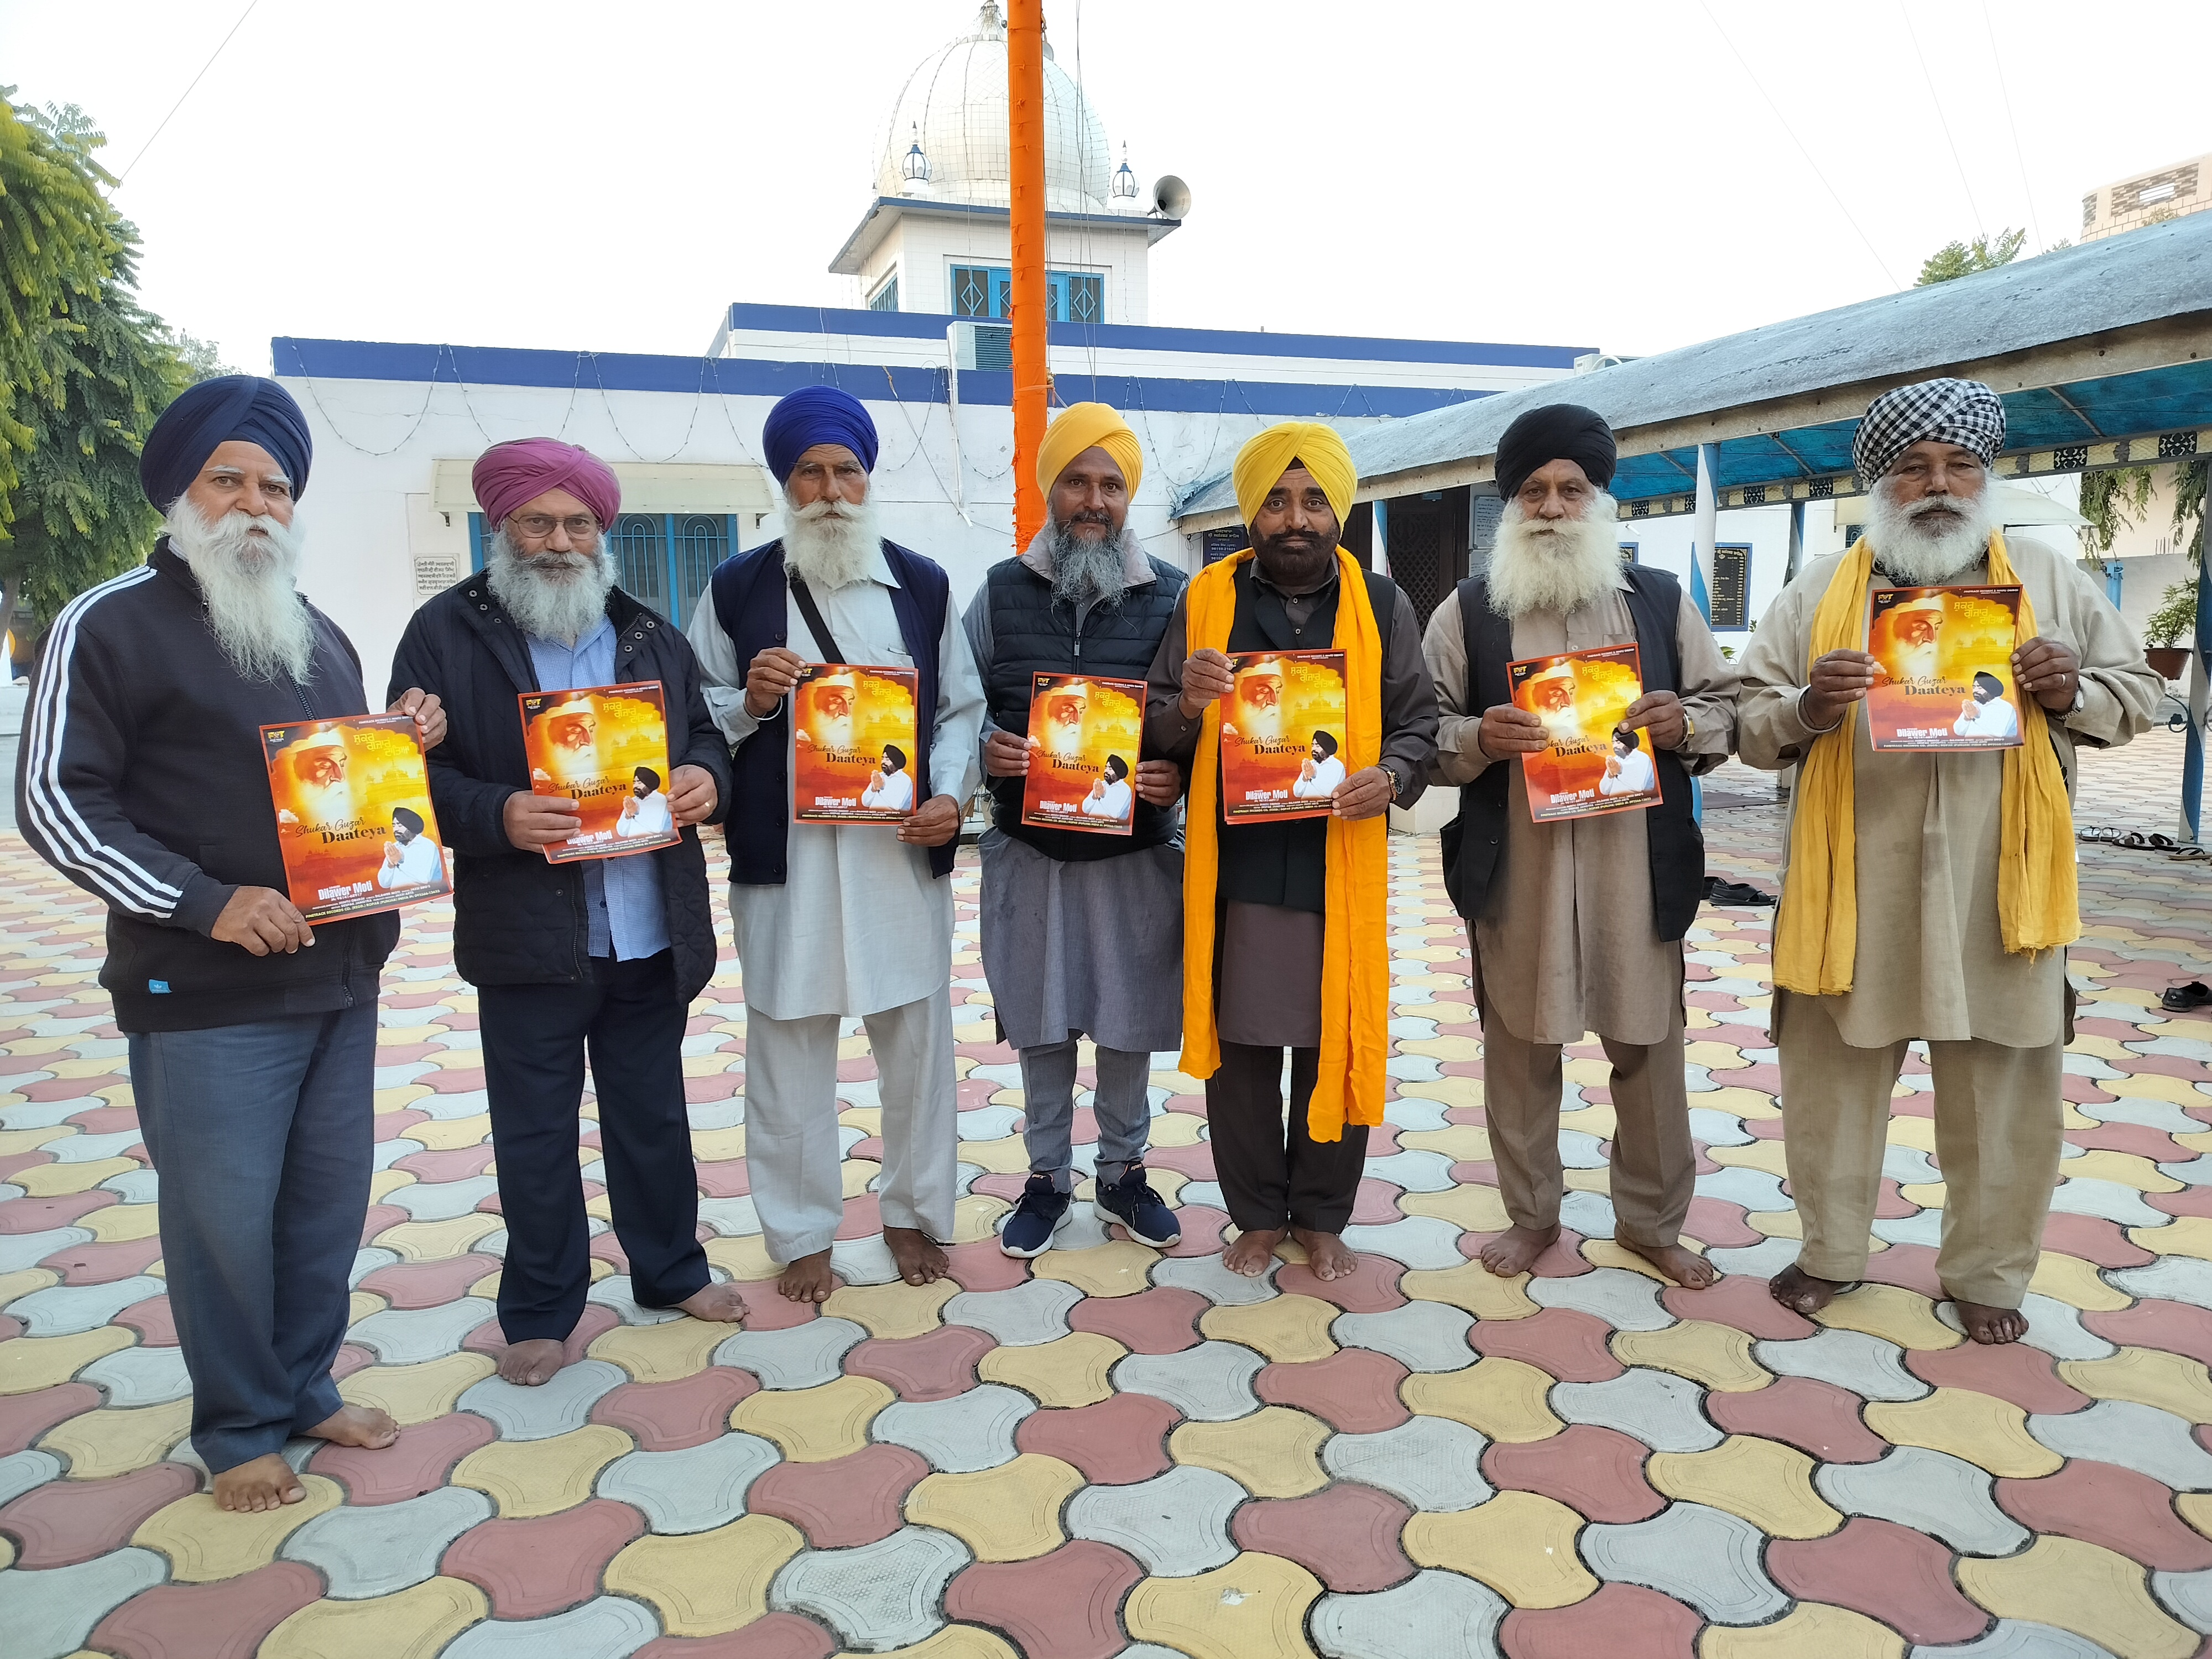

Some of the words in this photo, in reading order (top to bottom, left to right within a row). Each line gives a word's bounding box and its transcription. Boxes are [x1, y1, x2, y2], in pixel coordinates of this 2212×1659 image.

[1881, 676, 1916, 687] Shukar
[1918, 676, 1947, 687] Guzar
[1904, 685, 1966, 696] Daateya
[1896, 728, 1928, 737] Dilawer
[1929, 728, 1948, 737] Moti
[1234, 737, 1264, 747] Shukar
[1265, 735, 1291, 747] Guzar
[1548, 738, 1564, 747] kar
[1565, 734, 1590, 747] Guzar
[807, 744, 836, 753] Shukar
[837, 745, 862, 755] Guzar
[1036, 749, 1062, 759] Shukar
[1063, 752, 1087, 763] Guzar
[1254, 744, 1306, 755] Daateya
[1555, 743, 1608, 758] Daateya
[826, 753, 876, 766] Daateya
[1052, 759, 1099, 774] Daateya
[548, 780, 582, 794] Shukar
[582, 775, 611, 790] Guzar
[570, 782, 627, 800] Daateya
[1245, 791, 1271, 800] Dilawer
[1272, 789, 1288, 799] Moti
[1550, 792, 1577, 804] Dilawer
[1578, 788, 1595, 799] Moti
[842, 797, 857, 806] Moti
[1039, 800, 1062, 811] Dilawer
[1063, 802, 1077, 812] Moti
[295, 822, 332, 838] Shukar
[335, 816, 366, 831] Guzar
[321, 826, 387, 844] Daateya
[594, 830, 613, 841] Moti
[317, 886, 352, 900] Dilawer
[352, 880, 373, 894] Moti
